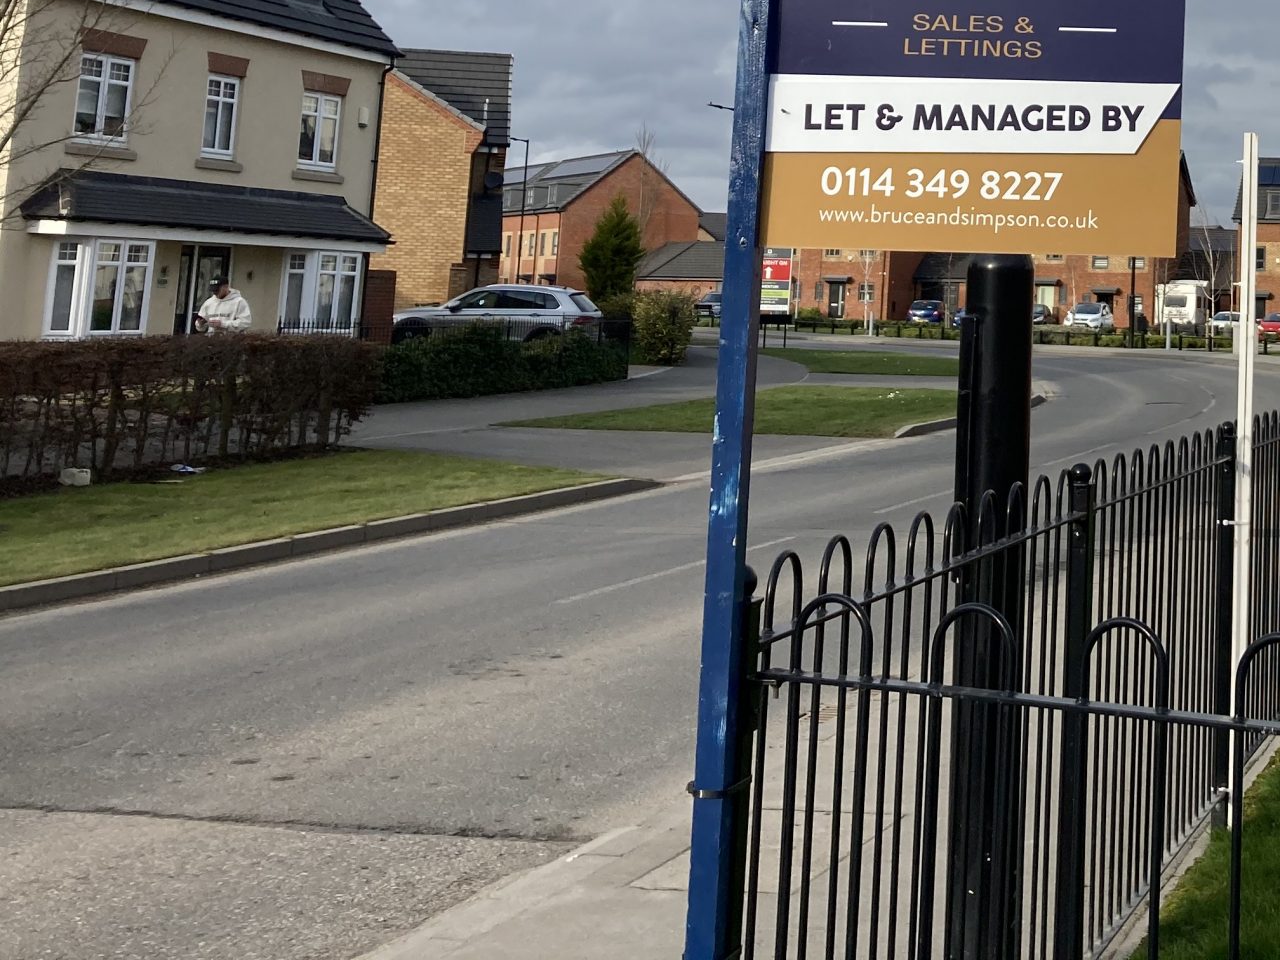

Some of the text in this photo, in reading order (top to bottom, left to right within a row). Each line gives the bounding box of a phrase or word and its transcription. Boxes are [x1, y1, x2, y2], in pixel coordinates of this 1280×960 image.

[913, 14, 1035, 34] SALES &
[903, 38, 1042, 59] LETTINGS
[804, 103, 1145, 132] LET & MANAGED BY
[820, 166, 1064, 201] 0114 349 8227
[818, 204, 1098, 234] www.bruceandsimpson.co.uk
